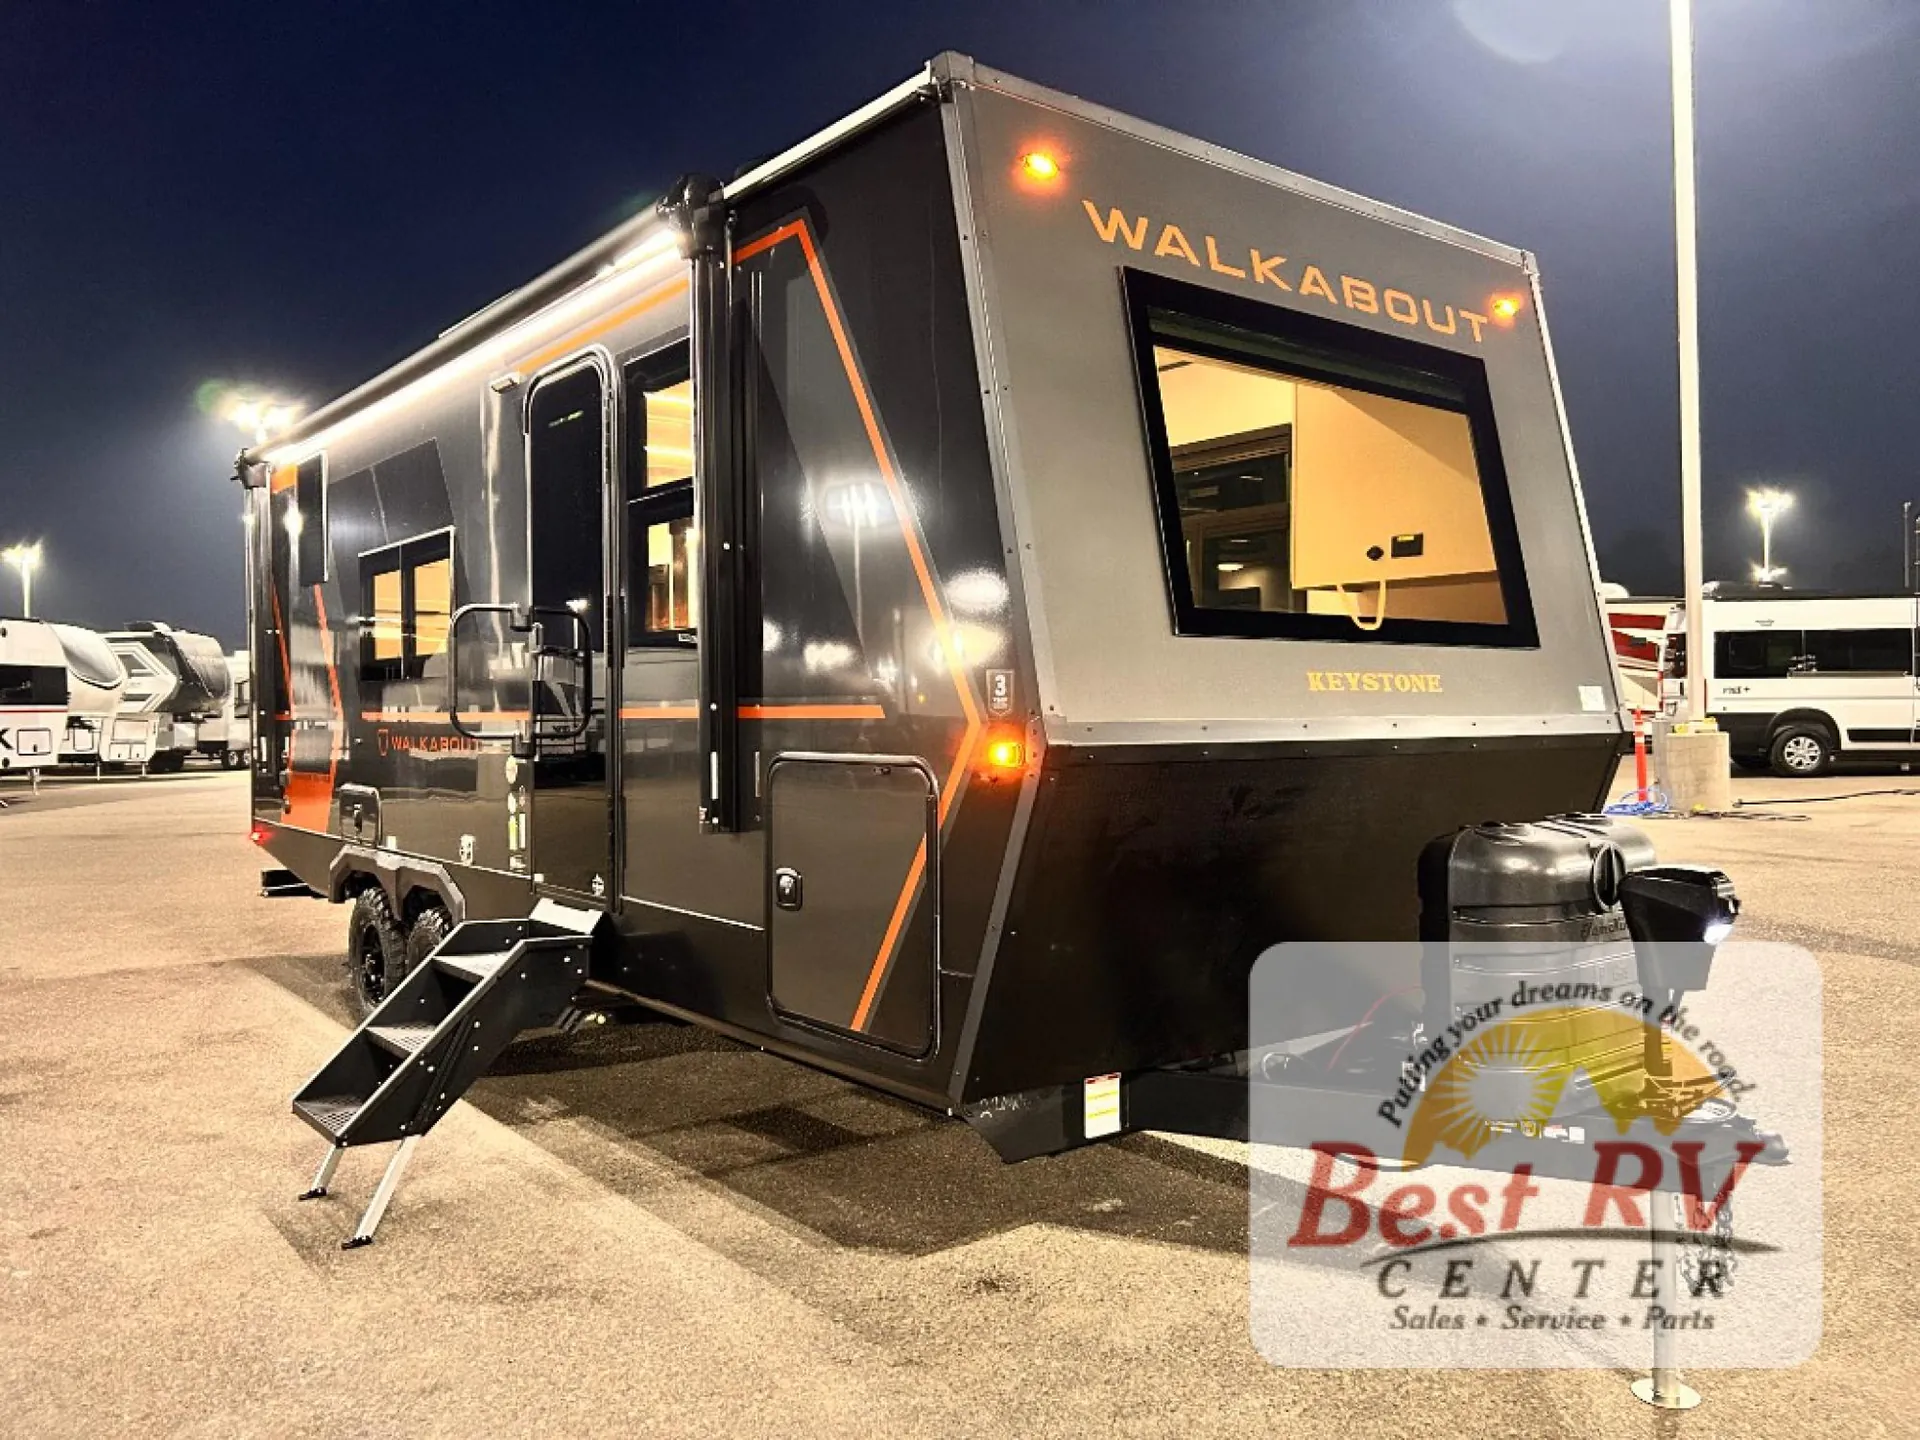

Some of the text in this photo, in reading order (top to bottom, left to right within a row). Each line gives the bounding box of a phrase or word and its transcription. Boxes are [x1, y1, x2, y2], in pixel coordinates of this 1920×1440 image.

[1082, 200, 1488, 343] WALKABOUT
[995, 674, 1006, 697] 3
[1306, 671, 1443, 693] KEYSTONE
[391, 736, 479, 753] WALKABOUT
